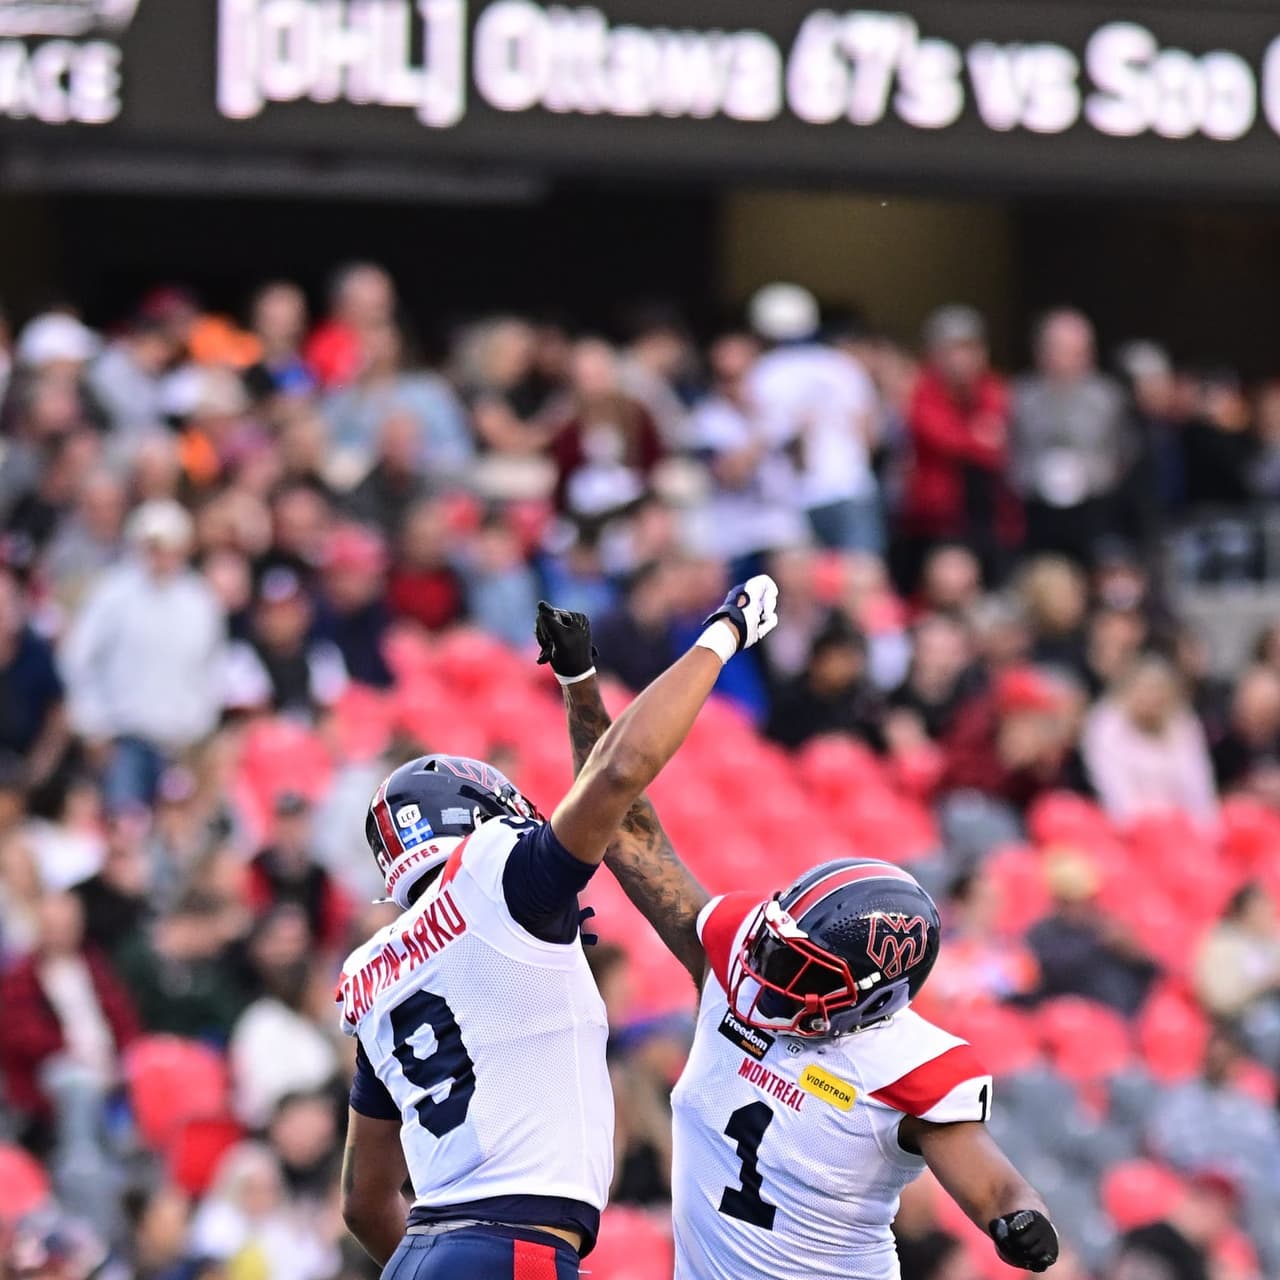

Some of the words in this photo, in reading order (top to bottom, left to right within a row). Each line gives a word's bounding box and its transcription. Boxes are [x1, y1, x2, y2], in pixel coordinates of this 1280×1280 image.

[473, 0, 782, 122] Ottawa
[787, 8, 962, 129] 67's
[969, 41, 1079, 133] vs
[1086, 22, 1257, 139] Soo
[400, 809, 417, 822] LCF
[343, 890, 467, 1025] CANTIN-ARKU
[724, 1013, 768, 1051] Freedom
[390, 989, 476, 1139] 9
[738, 1057, 806, 1112] MONTRÉAL
[806, 1073, 852, 1103] VIDÉOTRON
[978, 1084, 988, 1123] 1
[718, 1100, 776, 1231] 1
